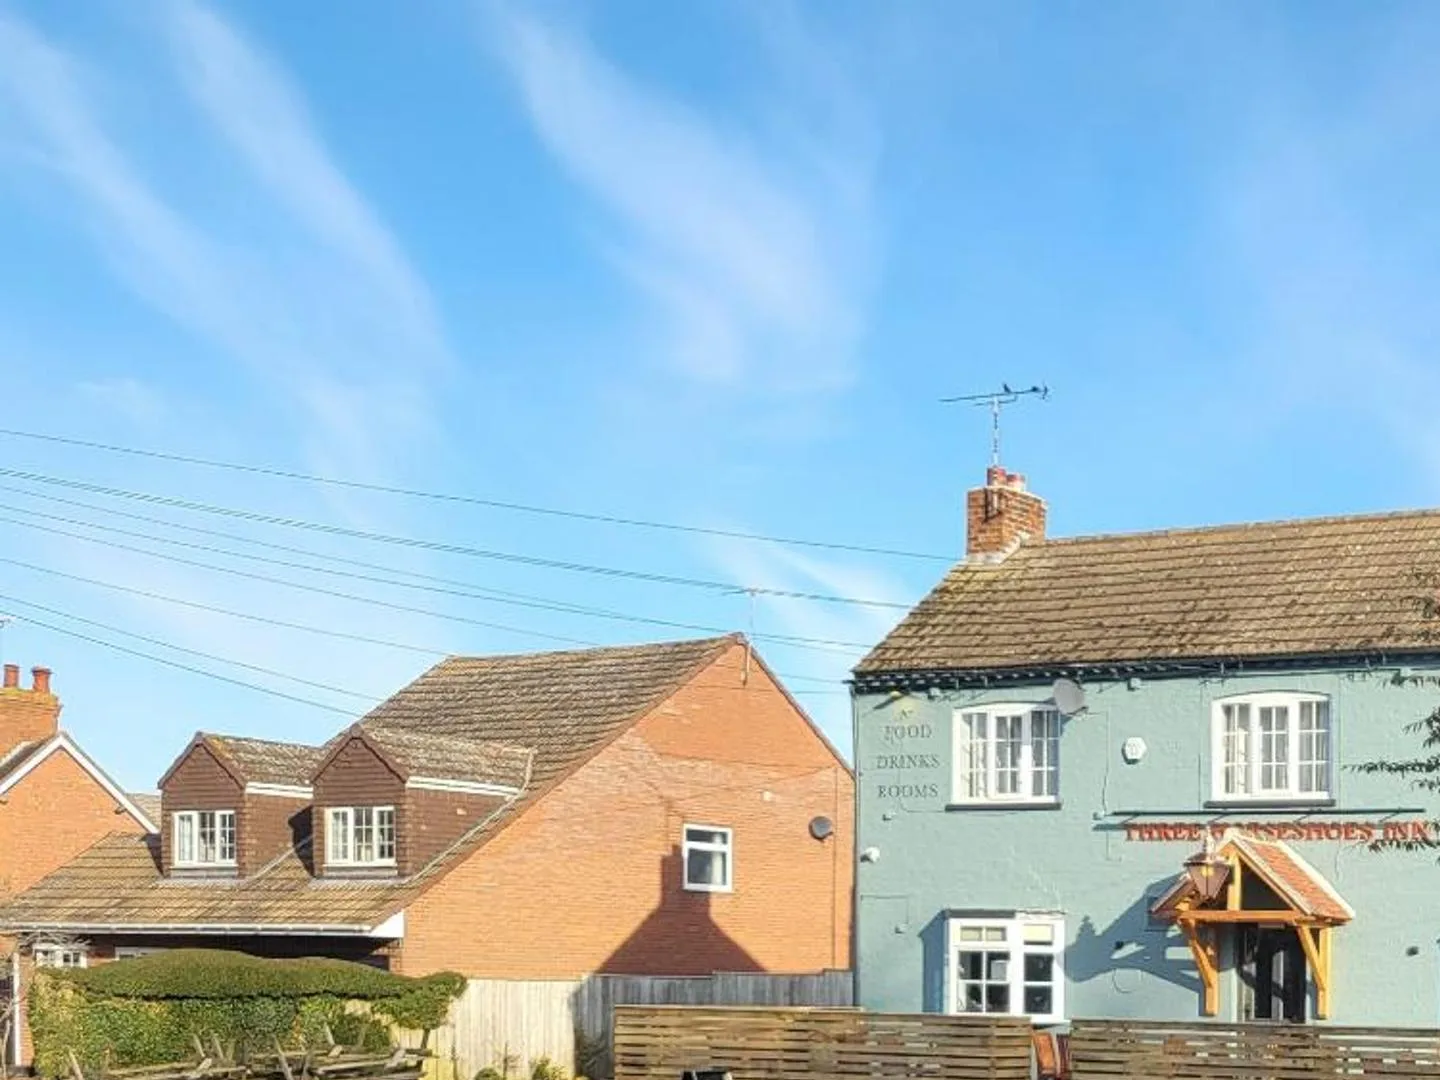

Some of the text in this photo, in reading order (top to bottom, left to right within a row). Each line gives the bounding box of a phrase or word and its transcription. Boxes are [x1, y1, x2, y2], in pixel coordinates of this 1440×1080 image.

[884, 724, 932, 740] FOOD
[876, 753, 940, 769] DRINKS
[877, 783, 938, 798] ROOMS
[1126, 819, 1429, 841] THREE HSESHOES INN
